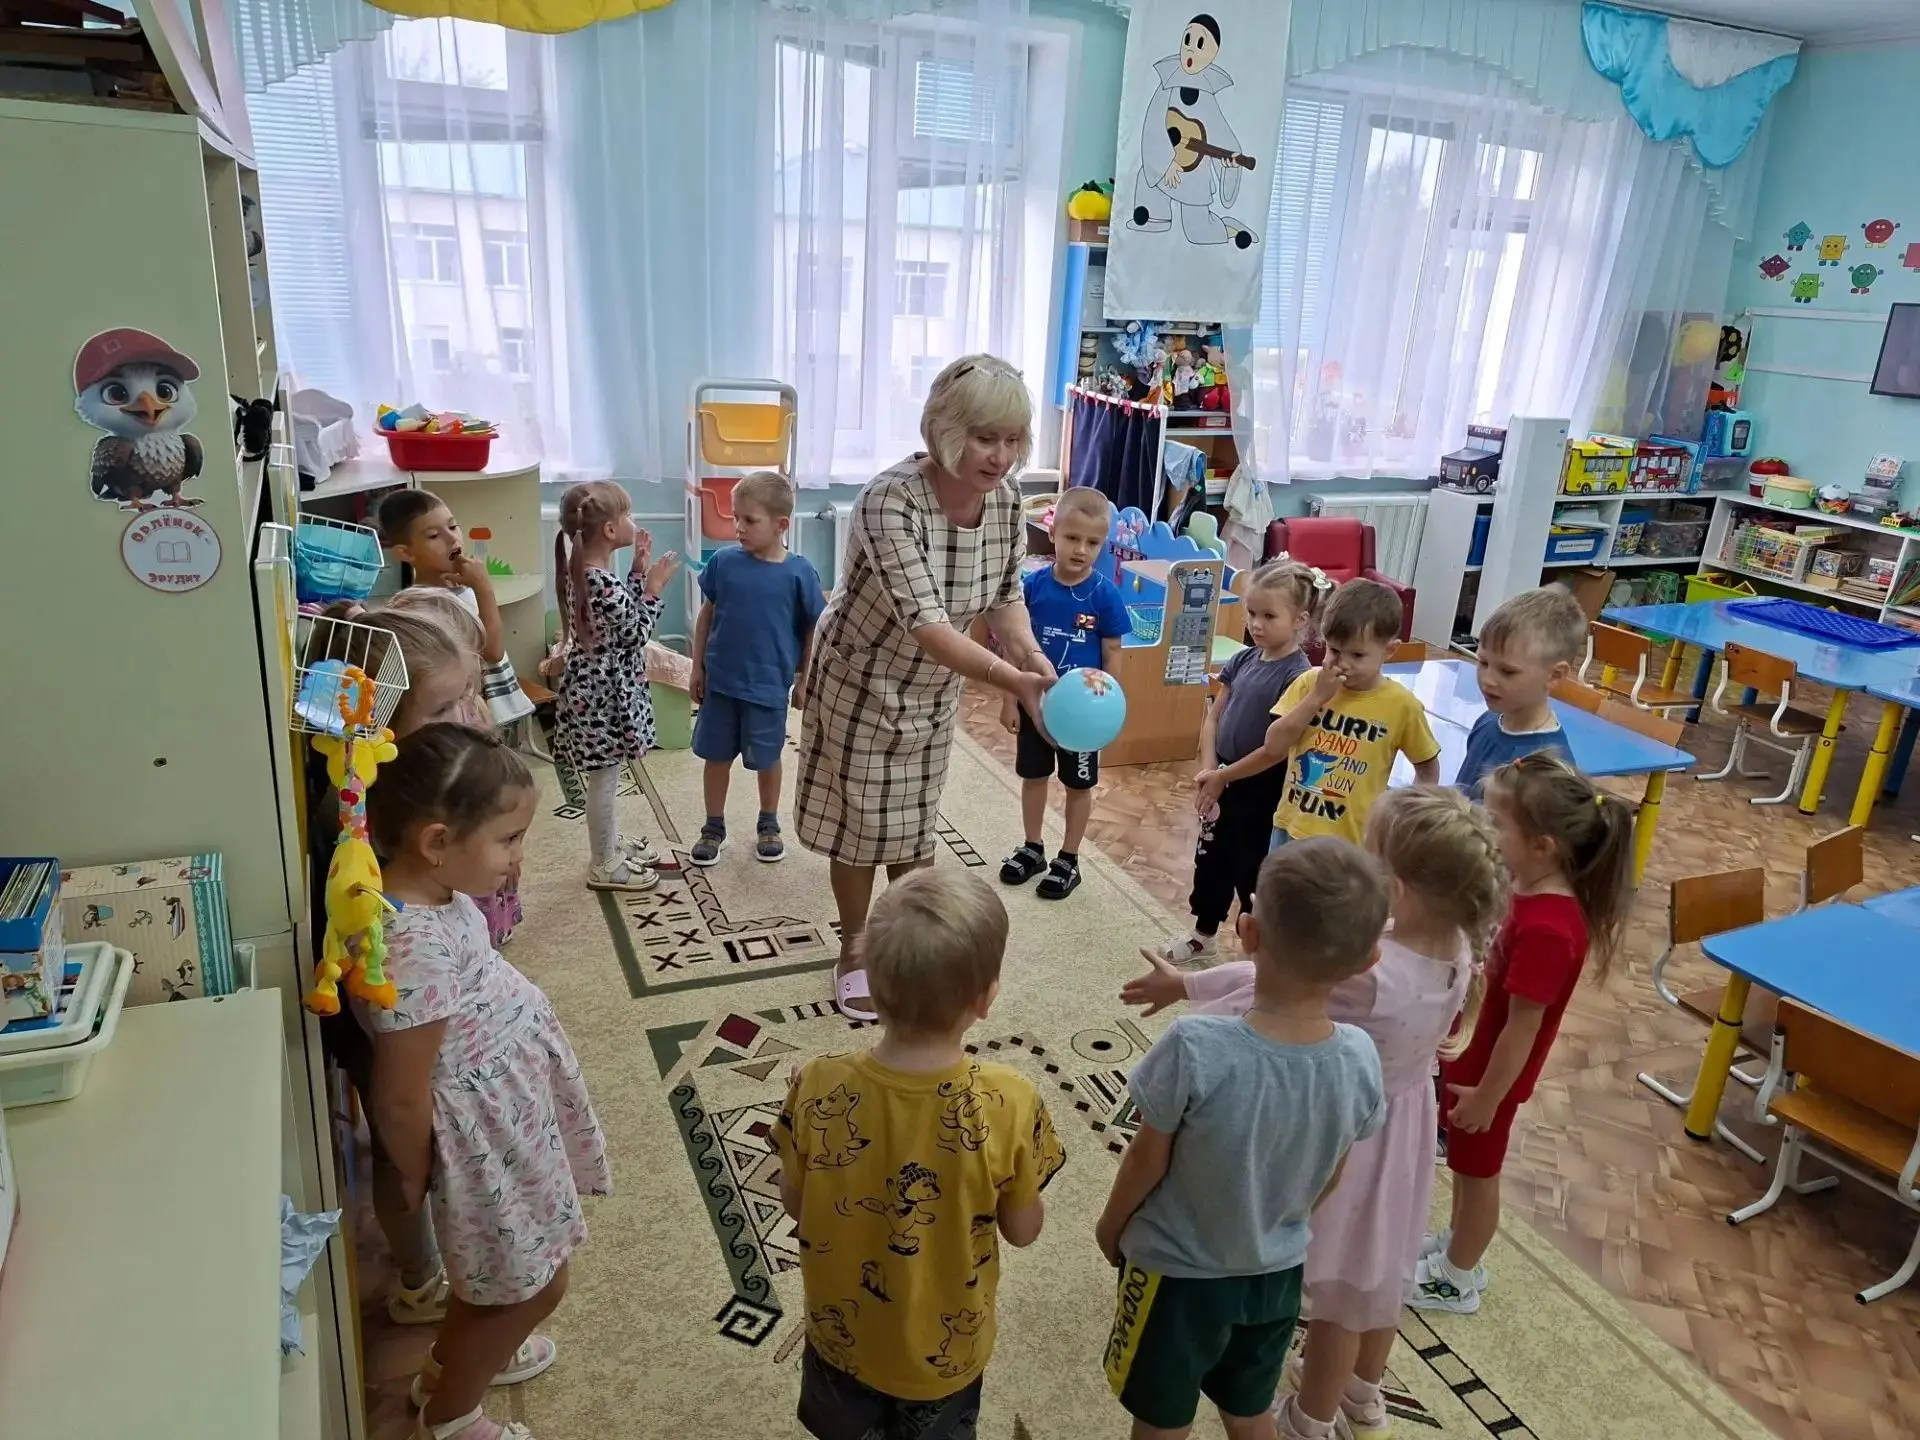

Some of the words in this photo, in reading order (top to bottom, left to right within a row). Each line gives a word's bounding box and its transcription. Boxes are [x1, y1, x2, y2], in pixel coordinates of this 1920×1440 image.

[1314, 730, 1358, 756] SAND
[1337, 756, 1368, 776] AND
[1326, 773, 1356, 794] SUN
[1287, 787, 1347, 821] FUN
